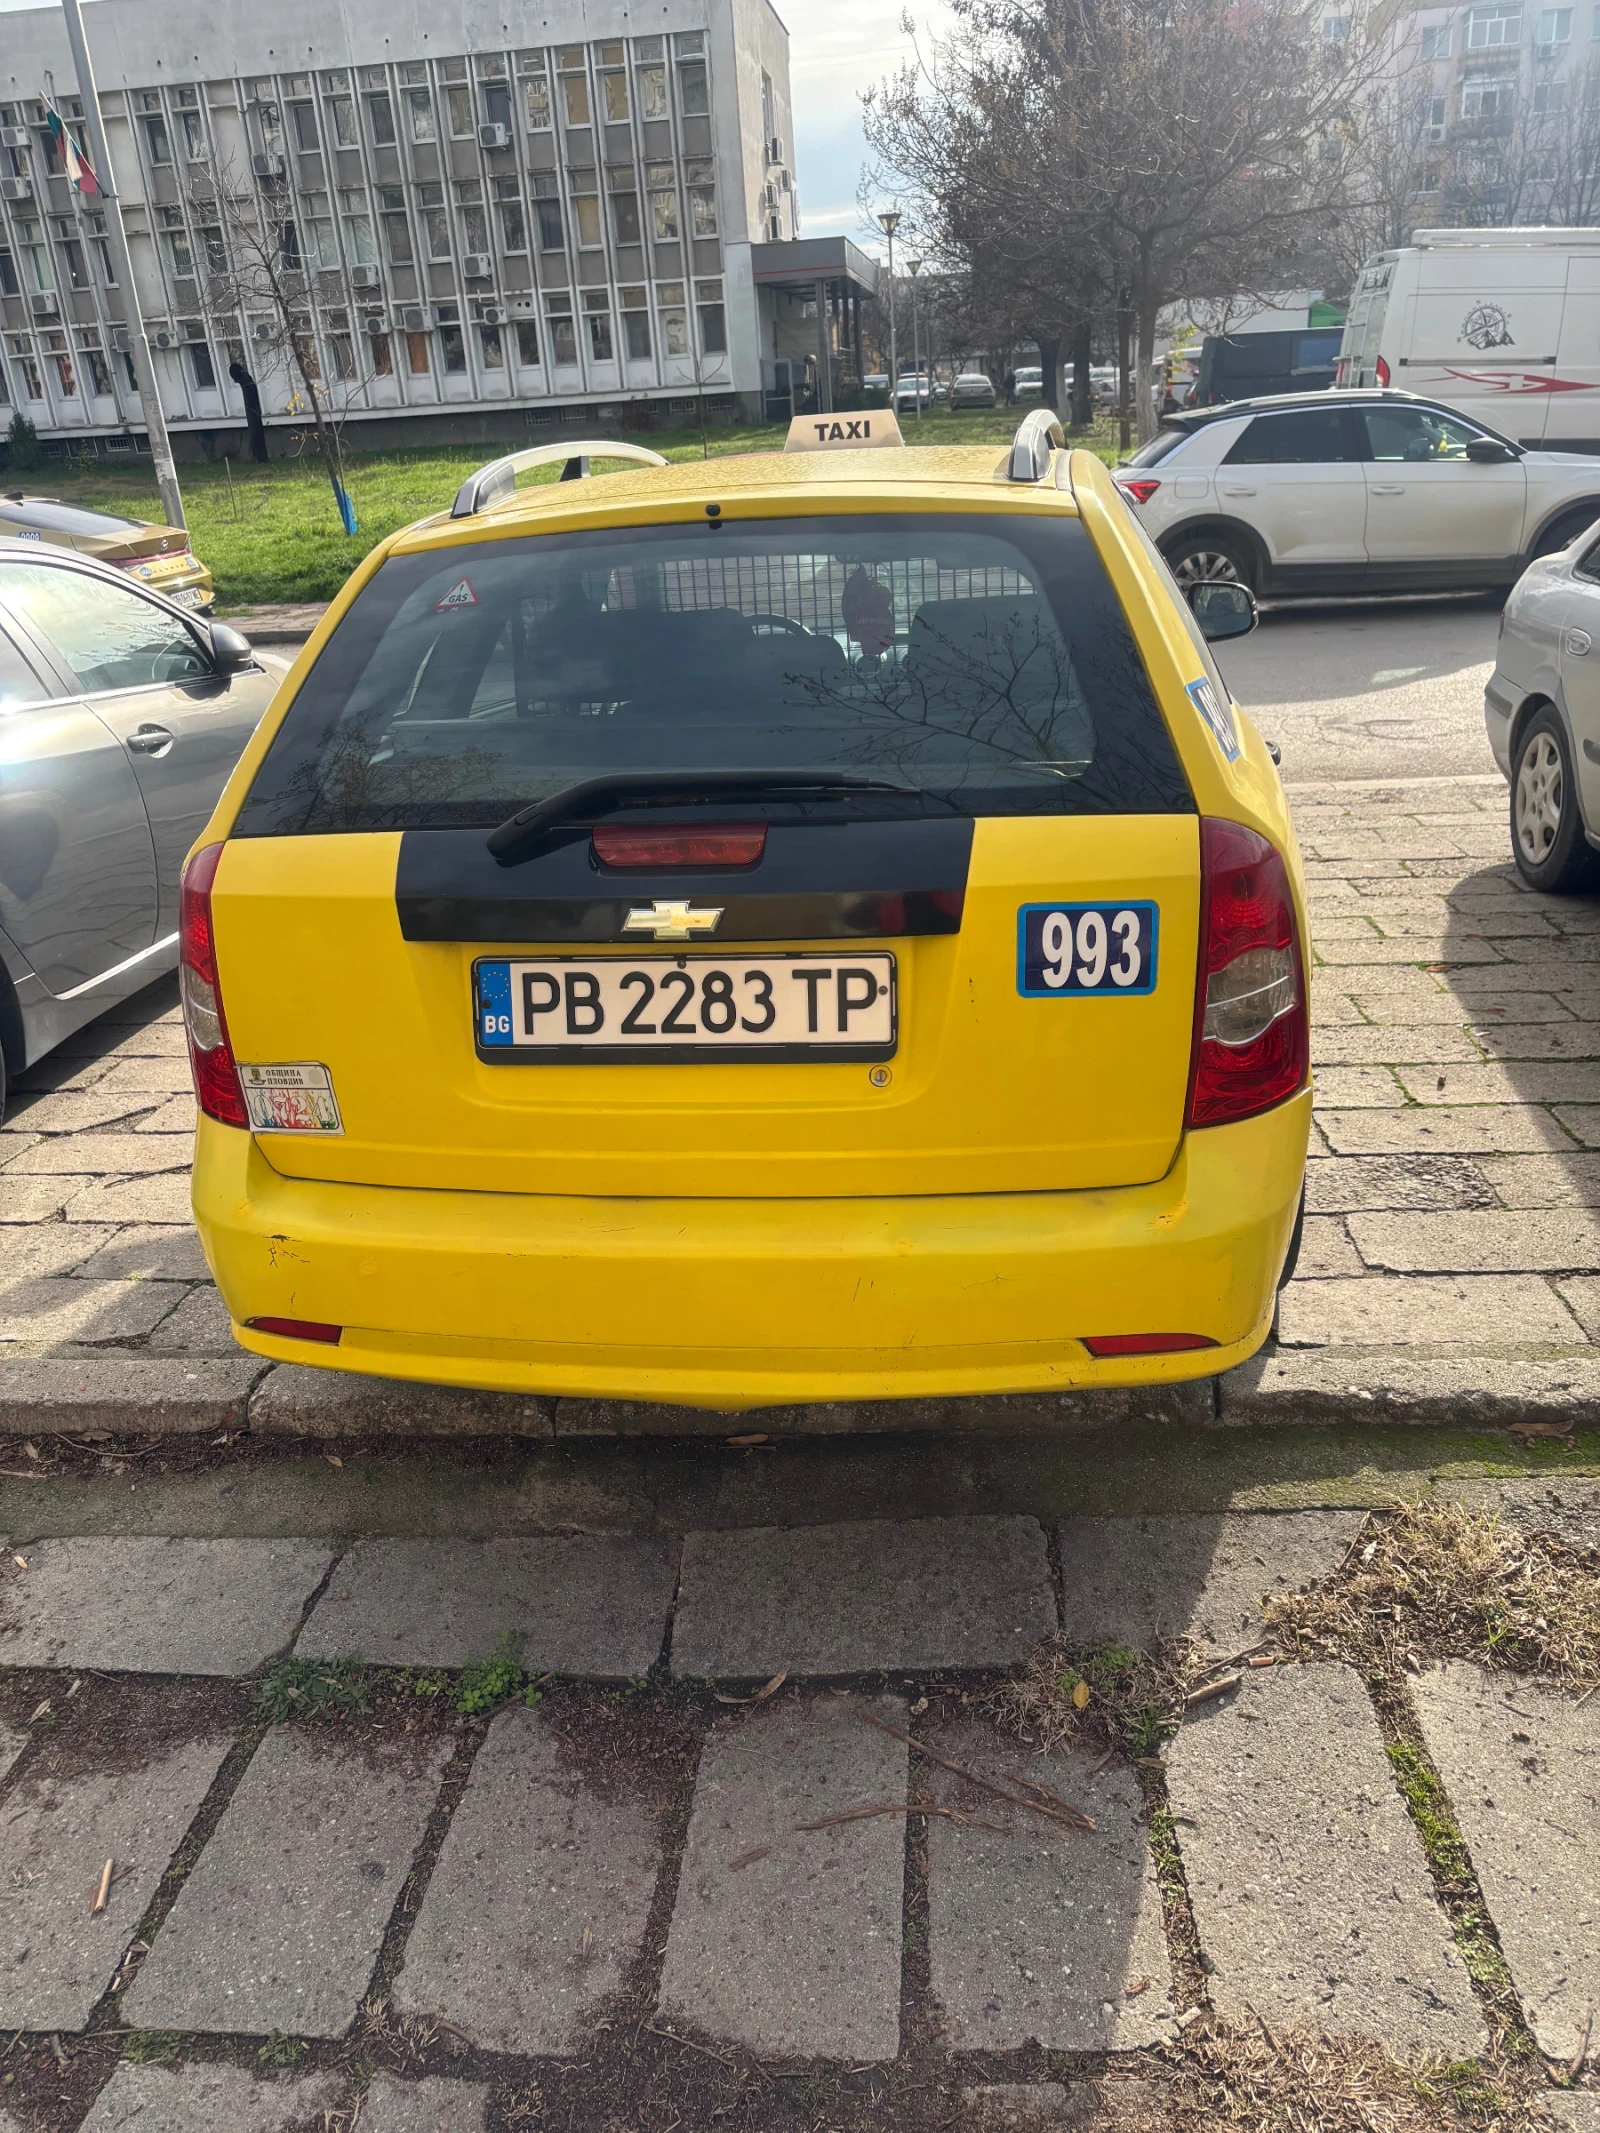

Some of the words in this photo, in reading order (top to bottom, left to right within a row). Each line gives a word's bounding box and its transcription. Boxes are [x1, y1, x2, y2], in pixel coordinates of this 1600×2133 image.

[814, 420, 871, 442] TAXI
[448, 593, 469, 604] GAS
[1042, 910, 1141, 988] 993
[521, 971, 605, 1036] PB
[619, 969, 777, 1035] 2283
[791, 968, 878, 1033] TP
[484, 1015, 510, 1034] BG
[265, 1068, 302, 1077] ОБЩИНА
[266, 1077, 304, 1086] ПЛОВДИВ
